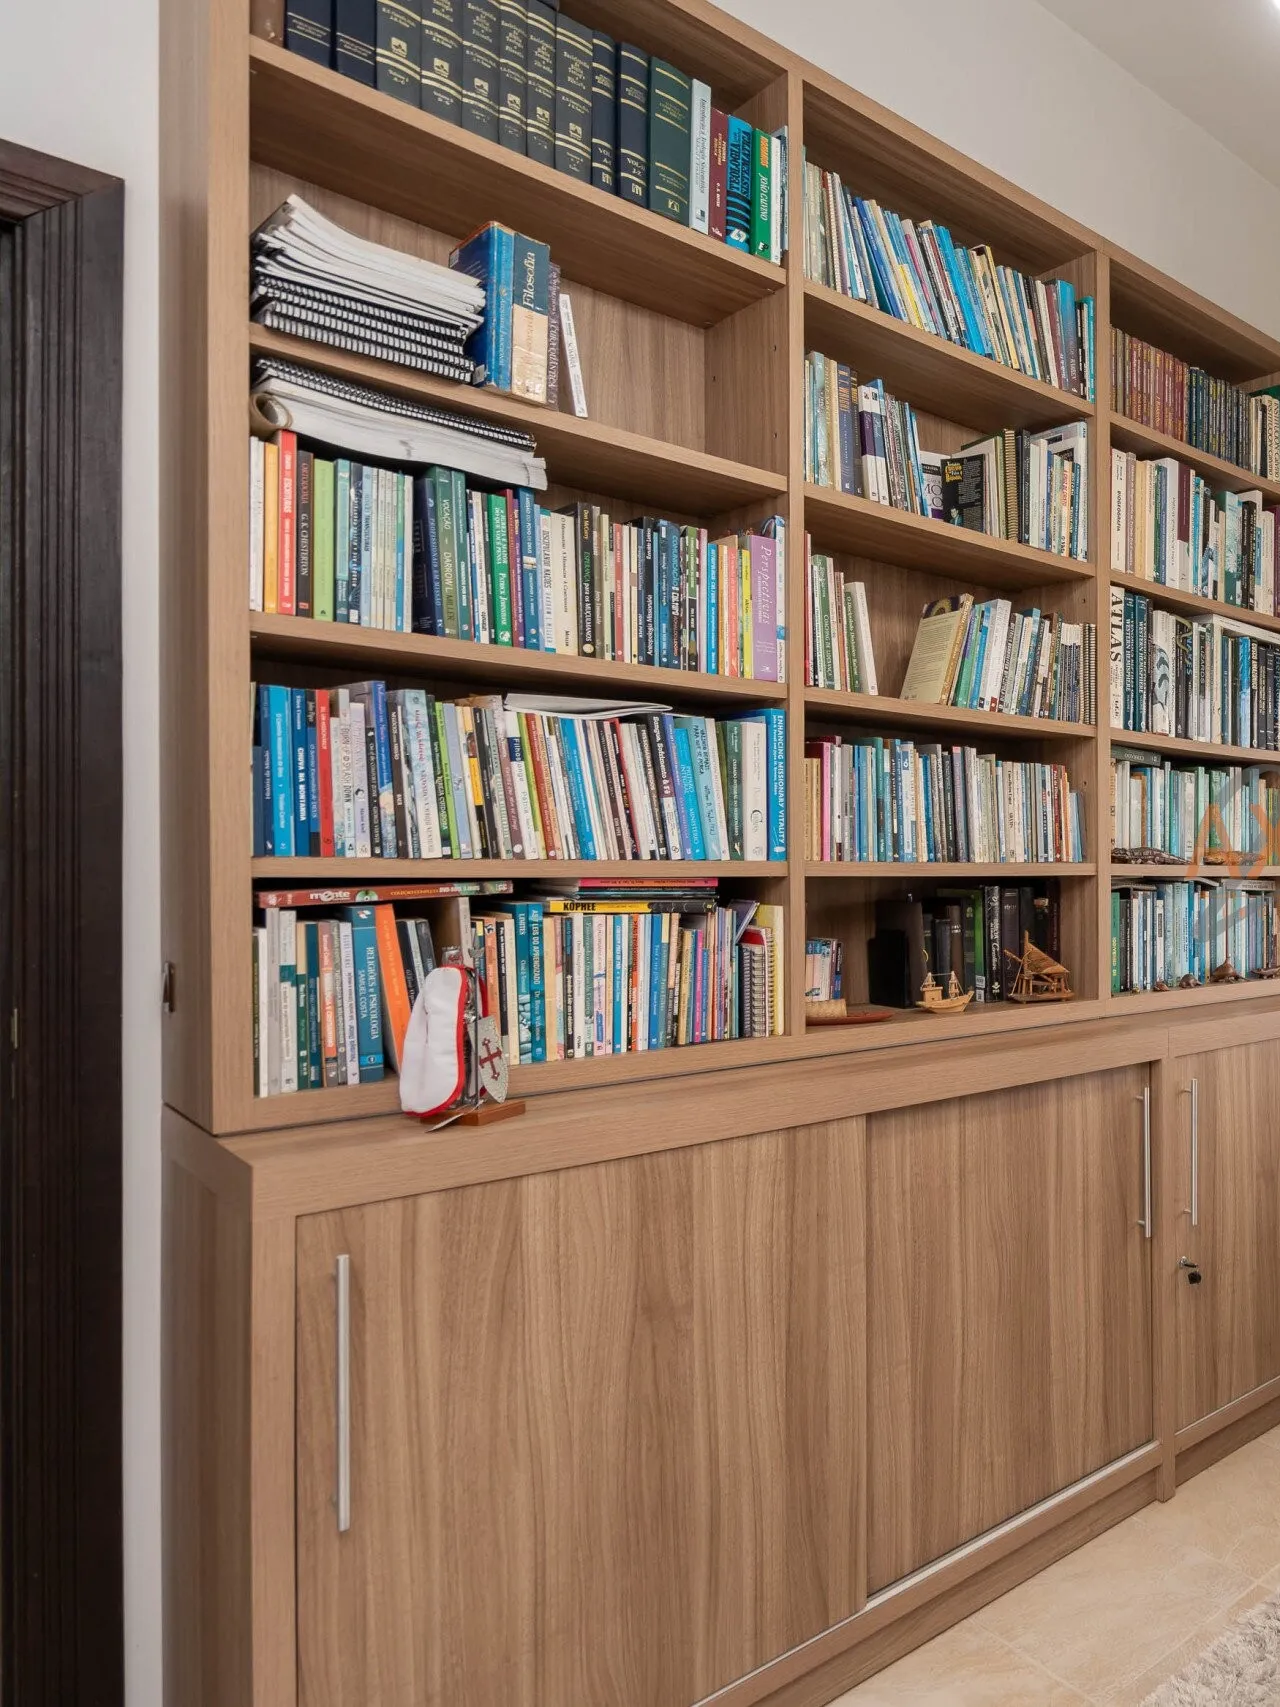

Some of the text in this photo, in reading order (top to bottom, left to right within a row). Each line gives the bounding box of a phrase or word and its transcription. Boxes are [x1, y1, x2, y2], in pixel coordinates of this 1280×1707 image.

[757, 544, 772, 626] Perspectivas
[1110, 593, 1123, 662] ATLAS
[1138, 653, 1146, 694] HEMISPHERE
[777, 715, 785, 760] ENHANCING
[777, 761, 785, 808] MISSIONARY
[368, 994, 380, 1040] PSICOLOGIA
